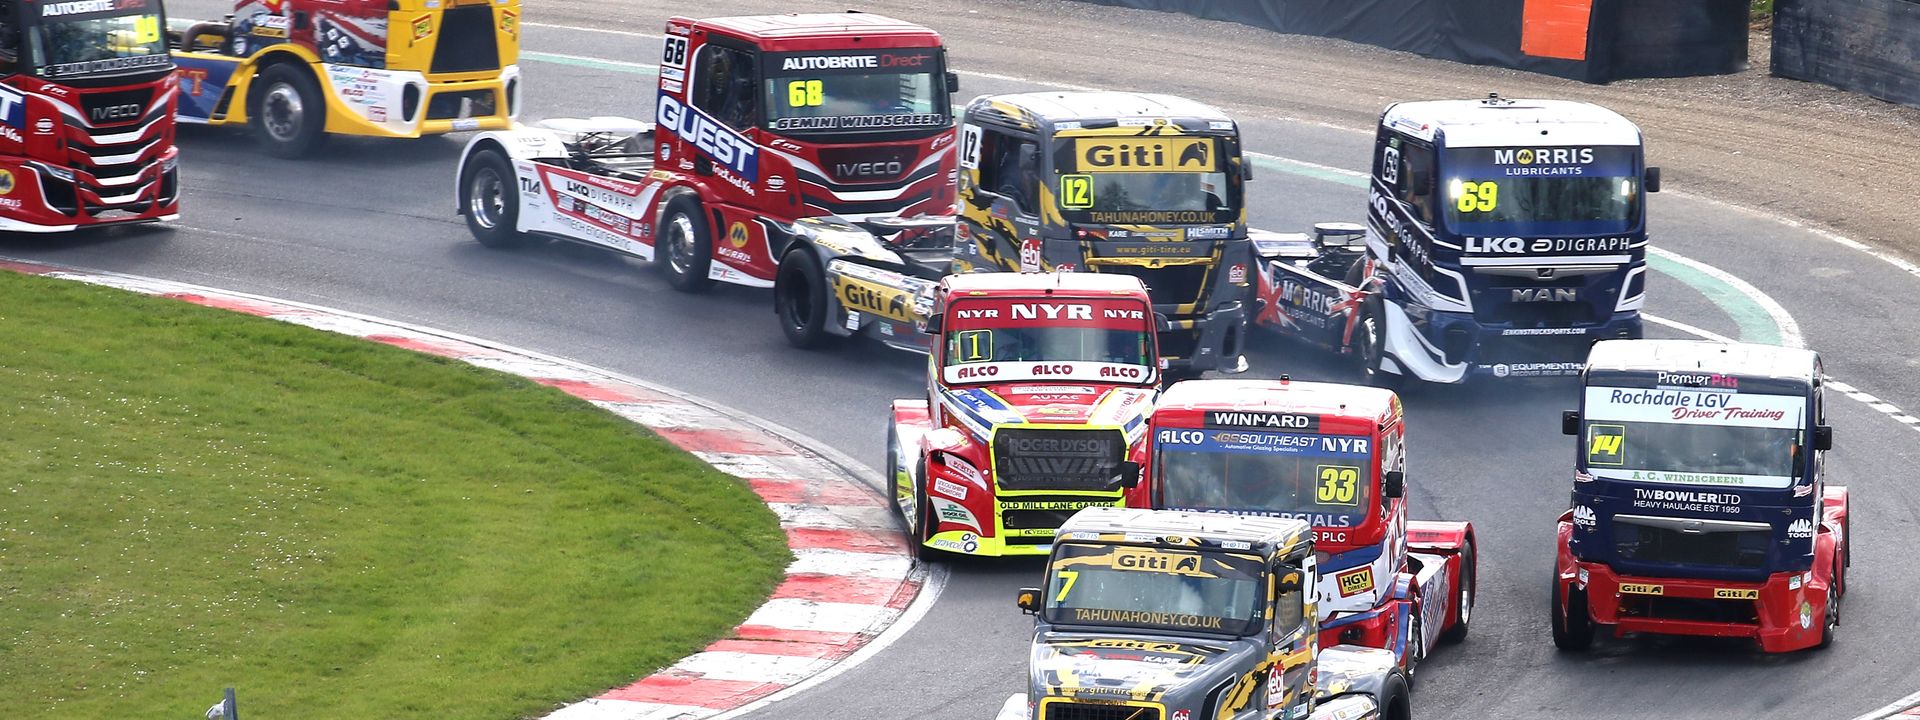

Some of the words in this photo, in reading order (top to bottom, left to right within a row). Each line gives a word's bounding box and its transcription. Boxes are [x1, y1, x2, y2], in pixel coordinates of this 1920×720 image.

[664, 37, 686, 65] 68
[782, 55, 878, 70] AUTOBRITE
[880, 53, 932, 67] Direct
[788, 79, 824, 108] 68
[92, 103, 141, 120] IVECO
[776, 117, 838, 130] GEMINI
[659, 94, 756, 172] GUEST
[963, 130, 978, 164] 12
[1085, 144, 1164, 167] Giti
[1494, 149, 1594, 165] MORRIS
[836, 161, 902, 177] IVECO
[1506, 167, 1583, 176] LUBRICANTS
[566, 180, 590, 198] LKQ
[1066, 178, 1089, 205] 12
[1457, 181, 1498, 213] 69
[1090, 210, 1216, 223] TAHUNAHONEY.CO.UK
[1115, 245, 1192, 256] www.giti-tire.eu
[1466, 237, 1526, 254] LKQ
[1556, 237, 1630, 251] DIGRAPH
[844, 283, 883, 311] Giti
[1282, 279, 1333, 316] MORRIS
[1511, 288, 1576, 302] MAN
[957, 309, 999, 319] NYR
[1011, 303, 1094, 321] NYR
[1103, 309, 1144, 319] NYR
[969, 333, 982, 360] 1
[958, 365, 999, 379] ALCO
[1032, 364, 1074, 376] ALCO
[1100, 366, 1140, 379] ALCO
[1511, 362, 1588, 371] EQUIPMENTHU
[1610, 389, 1691, 406] Rochdale
[1695, 393, 1732, 408] LGV
[1214, 412, 1309, 428] WINNARD
[1672, 407, 1721, 420] Driver
[1722, 407, 1785, 421] Training
[1158, 430, 1205, 445] ALCO
[1321, 437, 1368, 454] NYR
[1590, 435, 1623, 456] 14
[1318, 468, 1357, 502] 33
[1664, 474, 1744, 485] WINDSCREENS
[1000, 501, 1019, 509] OLD
[1022, 501, 1045, 509] MILL
[1047, 501, 1073, 509] LANE
[1634, 500, 1662, 509] HEAVY
[1662, 501, 1702, 512] HAULAGE
[1704, 504, 1719, 513] EST
[1721, 505, 1740, 514] 1950
[1787, 518, 1813, 533] MAC
[1322, 531, 1346, 542] PLC
[1117, 554, 1167, 570] Giti
[1055, 571, 1079, 602] 7
[1308, 565, 1316, 600] 7
[1341, 572, 1368, 588] HGV
[1347, 583, 1368, 592] DIRECT
[1621, 584, 1647, 593] Giti
[1716, 589, 1743, 598] Giti
[1075, 608, 1222, 629] TAHUNAHONEY.CO.UK
[1094, 640, 1146, 648] Giti
[1268, 667, 1285, 694] febi
